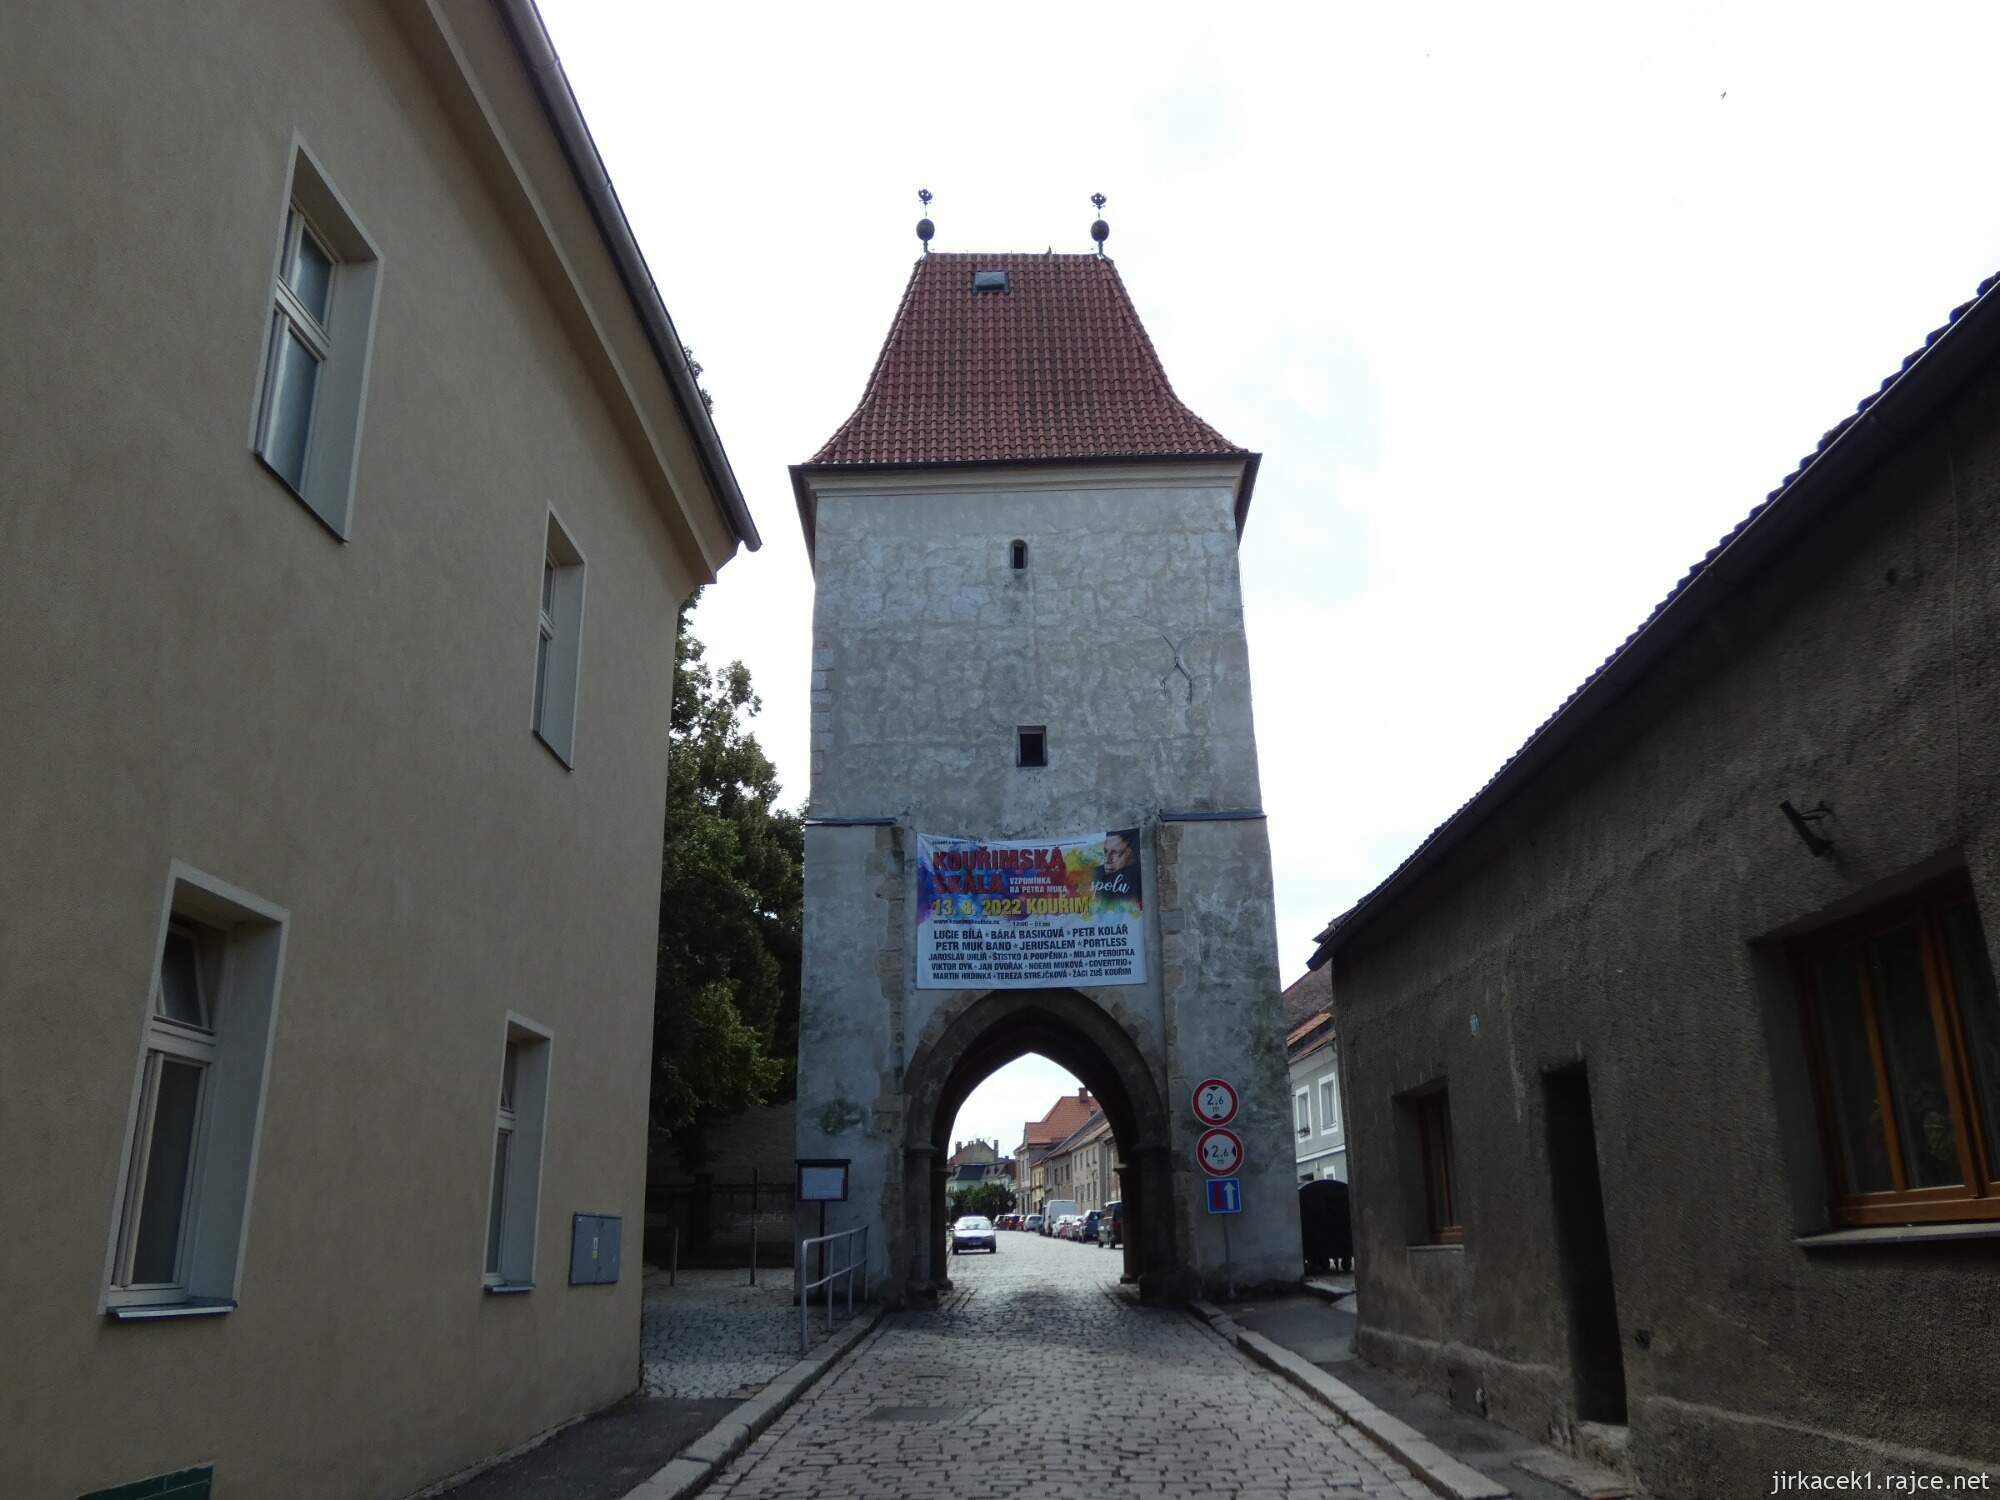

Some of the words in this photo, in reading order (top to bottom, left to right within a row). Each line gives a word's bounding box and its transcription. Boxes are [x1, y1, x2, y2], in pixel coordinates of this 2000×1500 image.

[933, 846, 1067, 871] KOUŘIMSKÁ
[1009, 876, 1051, 885] VZPOMÍNKA
[983, 897, 1021, 916] 2022
[1027, 895, 1090, 914] KOUŘIM
[934, 930, 960, 940] LUCIE
[962, 928, 983, 939] BÍLÁ
[991, 928, 1016, 939] BÁRA
[1019, 927, 1064, 939] BASIKOVÁ
[1073, 926, 1095, 937] PETR
[1098, 923, 1128, 936] KOLÁŘ
[936, 941, 960, 951] PETR
[962, 941, 983, 951] MUK
[986, 941, 1012, 951] BAND
[1020, 939, 1075, 950] JERUSALEM
[1083, 937, 1126, 948] PORTLESS
[929, 952, 965, 961] JAROSLAV
[1074, 951, 1096, 959] MILAN
[1098, 948, 1135, 957] PEROUTKA
[932, 962, 957, 971] VIKTOR
[959, 962, 972, 970] DYK
[979, 962, 992, 970] JAN
[994, 961, 1023, 970] DVOŘÁK
[1029, 962, 1051, 970] NOEMI
[1054, 959, 1083, 969] MUKOVÁ
[933, 972, 960, 980] MARTIN
[997, 972, 1022, 980] TEREZA
